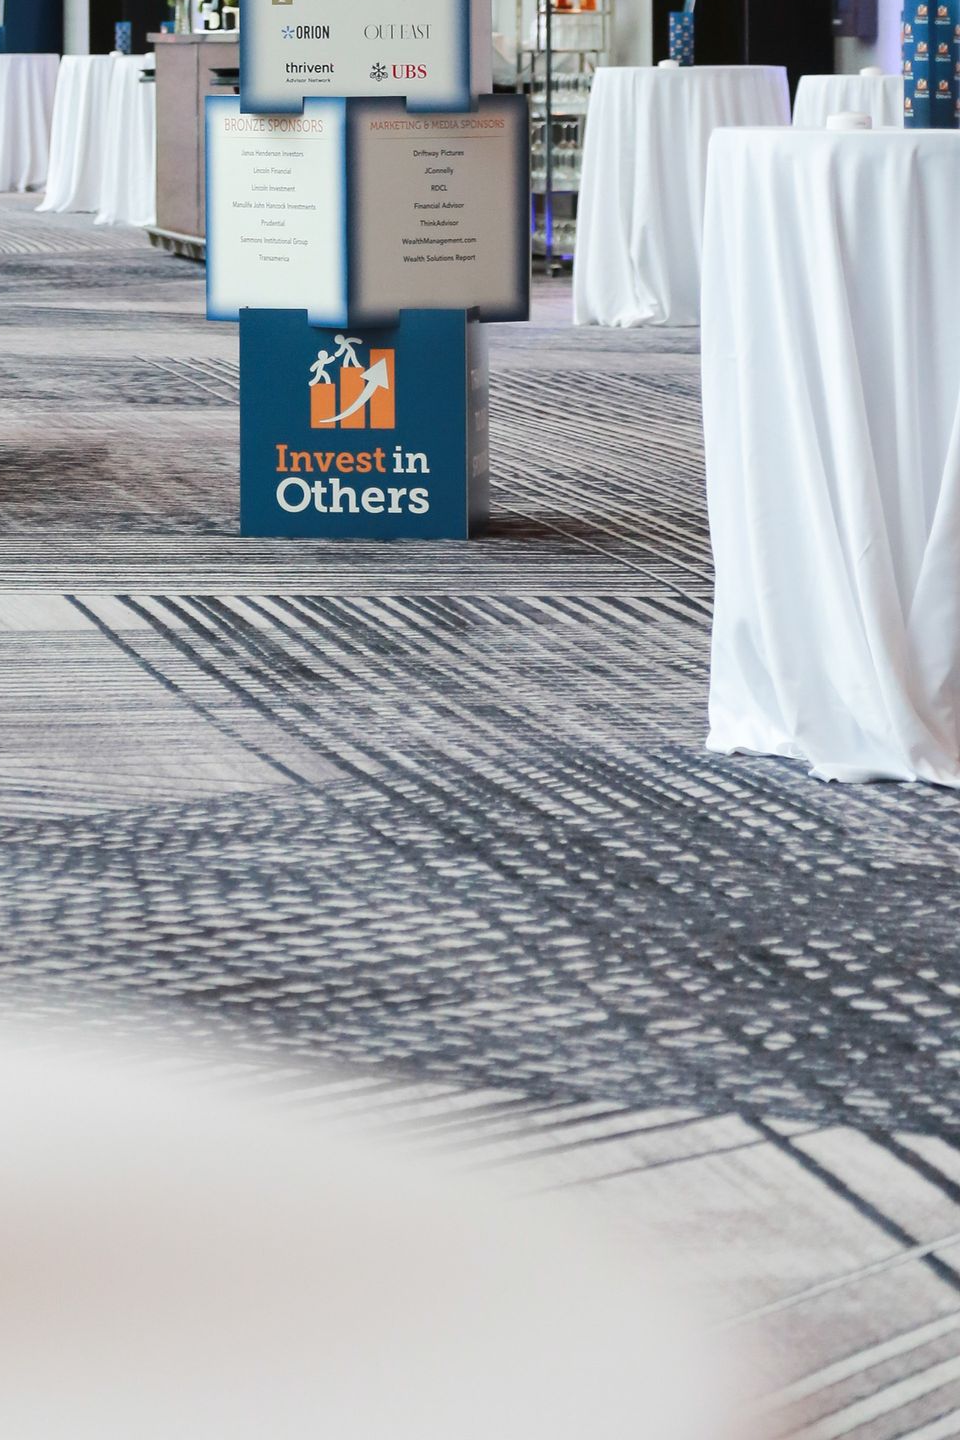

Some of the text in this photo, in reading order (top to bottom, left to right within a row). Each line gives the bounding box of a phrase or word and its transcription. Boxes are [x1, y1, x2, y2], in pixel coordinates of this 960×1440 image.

[296, 25, 330, 40] ORION
[364, 24, 433, 40] OUT EAST
[285, 62, 334, 73] thrivent
[391, 64, 427, 79] UBS
[224, 118, 324, 133] BRONZE SPONSORS
[370, 119, 505, 130] MARKETING & MEDIA SPONSORS
[413, 149, 464, 158] Driftway Pictures
[424, 167, 454, 175] JConnelly
[401, 237, 477, 246] WealthManagement.com
[403, 254, 476, 263] Wealth Solutions Report
[276, 444, 430, 474] Invest in
[276, 476, 430, 515] Others
